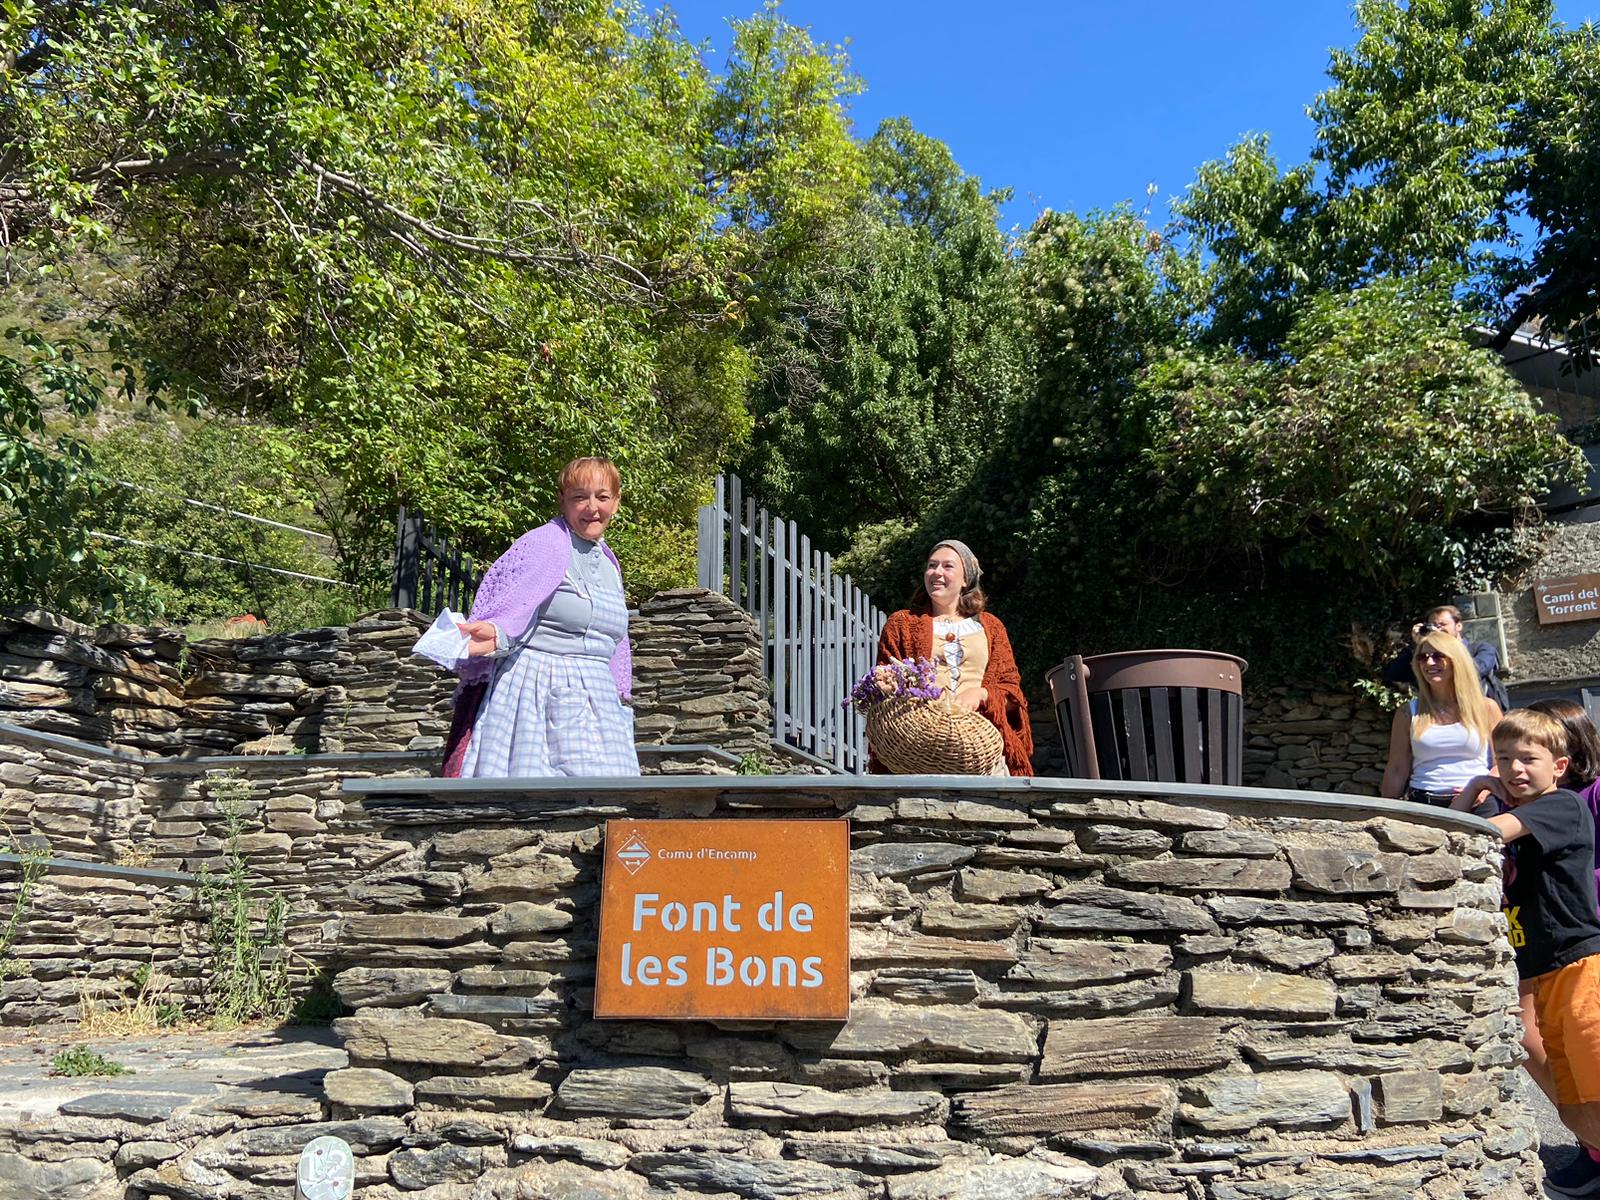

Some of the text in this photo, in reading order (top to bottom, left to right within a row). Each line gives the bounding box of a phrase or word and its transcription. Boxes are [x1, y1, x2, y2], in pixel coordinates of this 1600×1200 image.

[1542, 587, 1599, 604] Camí del
[1547, 601, 1597, 615] Torrent
[697, 848, 757, 861] d'Encamp
[632, 890, 814, 932] Font de
[620, 942, 824, 987] les Bons
